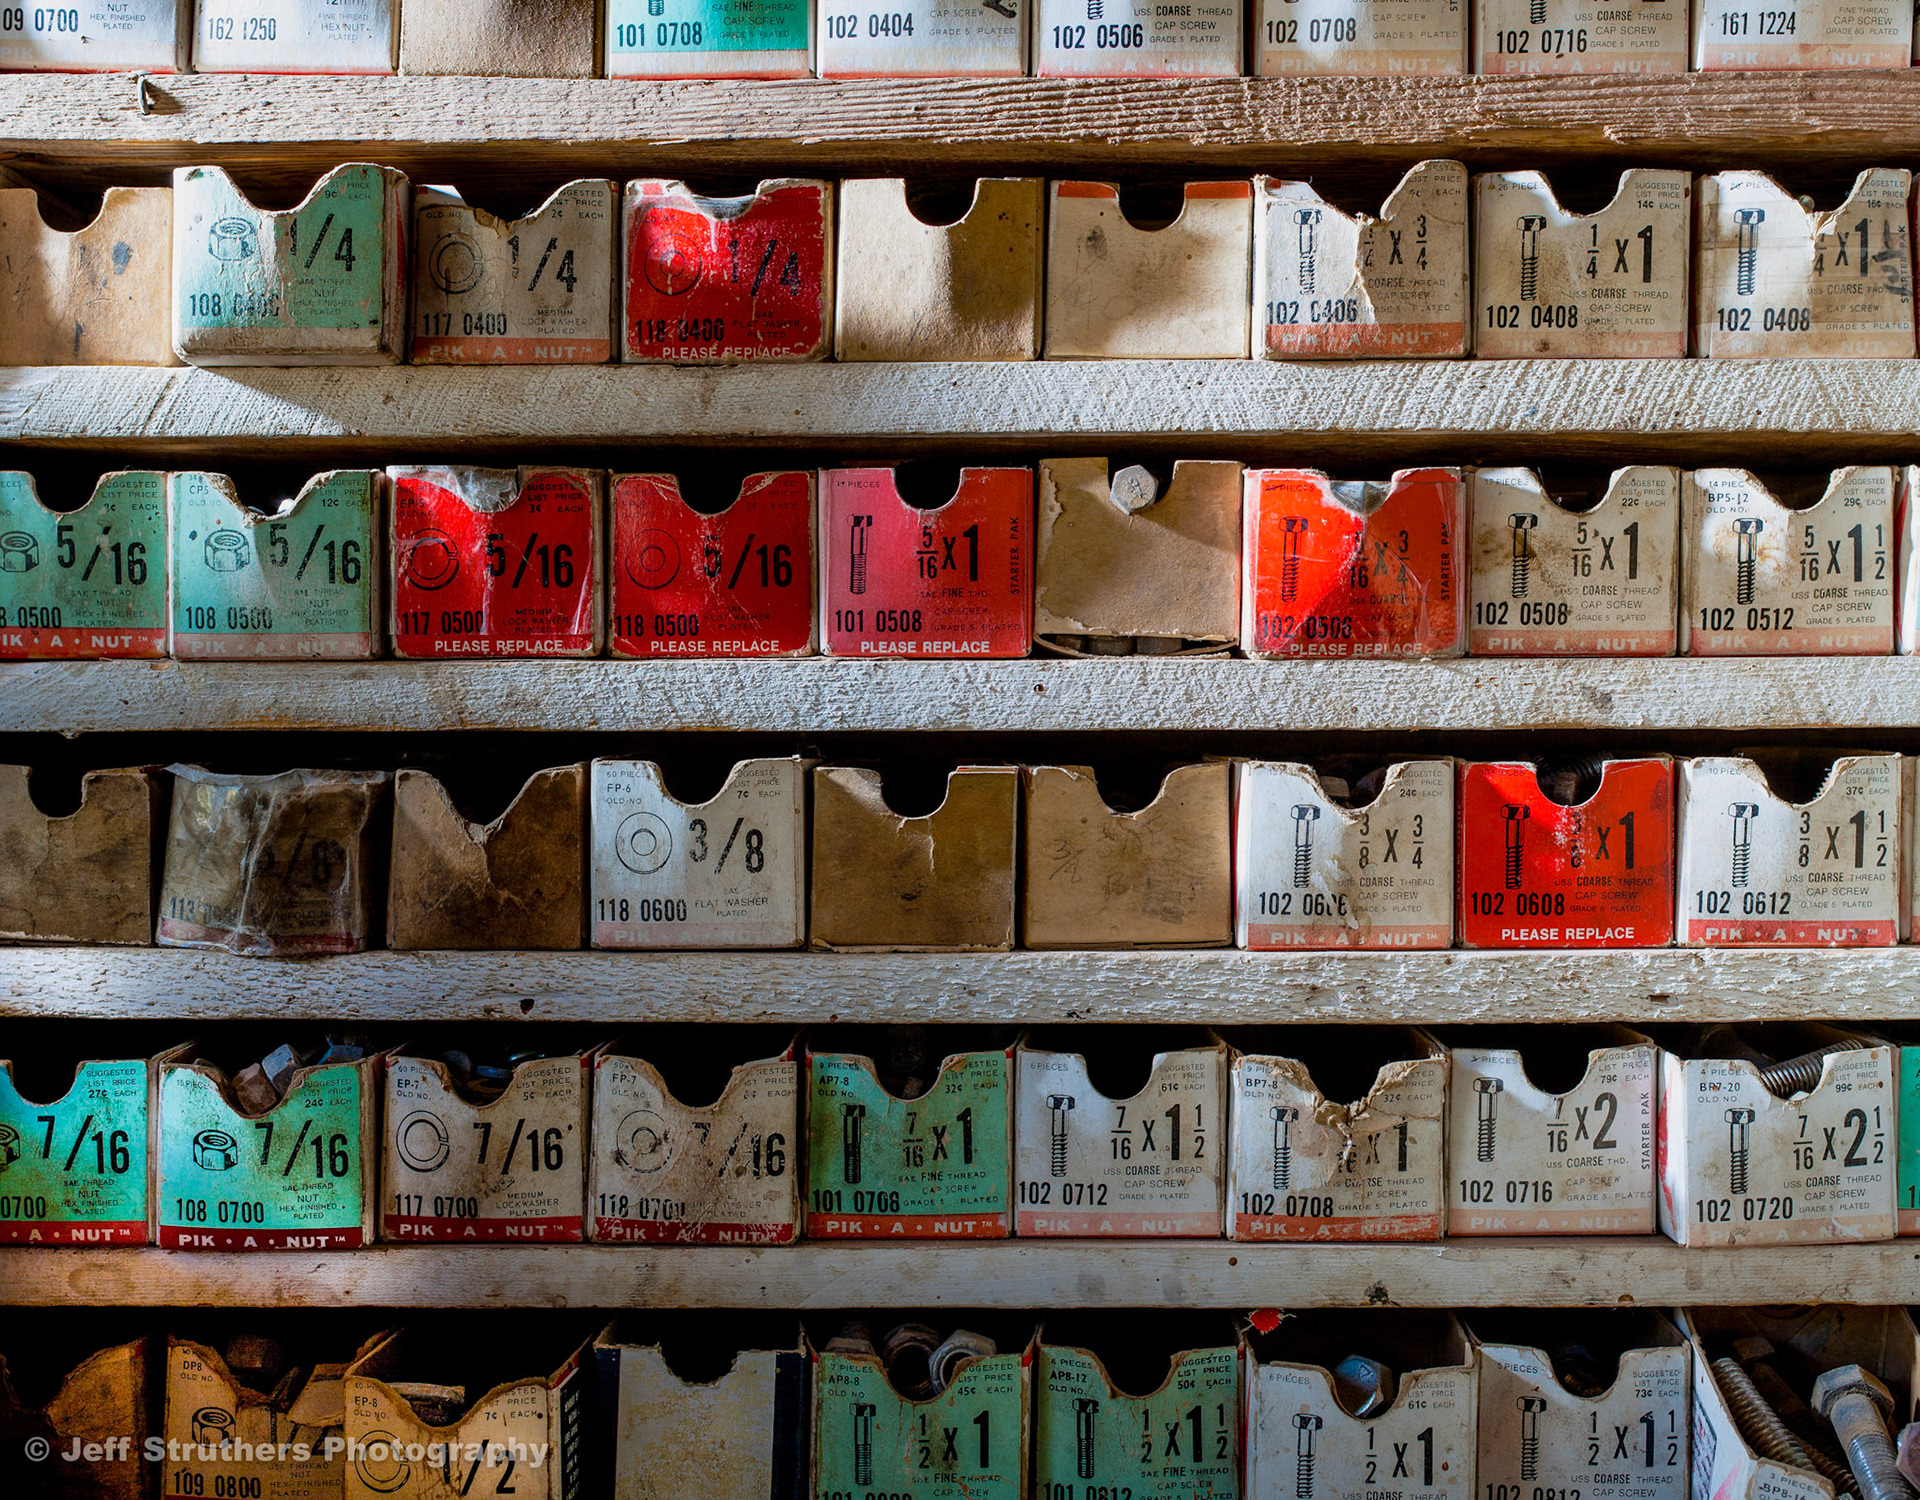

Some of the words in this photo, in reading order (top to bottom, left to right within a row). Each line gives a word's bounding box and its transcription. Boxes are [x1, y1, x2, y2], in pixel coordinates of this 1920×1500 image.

[1155, 5, 1192, 16] COARSE
[34, 8, 79, 32] 0700
[826, 15, 857, 39] 102
[869, 13, 915, 38] 0404
[1155, 20, 1177, 30] CAP
[1180, 20, 1218, 30] SCREW
[1721, 13, 1749, 36] 161
[1757, 12, 1796, 36] 1224
[1833, 16, 1854, 26] CAP
[1857, 16, 1893, 26] SCREW
[208, 18, 234, 40] 162
[243, 18, 277, 41] 1250
[617, 23, 646, 47] 101
[656, 21, 703, 47] 0708
[1052, 25, 1086, 49] 102
[1096, 24, 1145, 49] 0506
[1267, 20, 1299, 44] 102
[1309, 18, 1357, 43] 0708
[1496, 29, 1529, 54] 102
[1541, 28, 1588, 54] 0716
[1634, 182, 1681, 190] SUGGESTED
[1658, 202, 1681, 210] EACH
[578, 212, 605, 221] EACH
[1591, 287, 1628, 299] COARSE
[1632, 291, 1670, 299] THREAD
[189, 293, 222, 318] 108
[1266, 301, 1300, 325] 102
[1487, 305, 1520, 329] 102
[1530, 305, 1579, 329] 0408
[1717, 307, 1752, 332] 102
[1763, 307, 1812, 332] 0408
[422, 313, 453, 337] 117
[463, 312, 508, 336] 0400
[635, 318, 667, 343] 118
[677, 317, 725, 342] 0400
[662, 347, 720, 360] PLEASE
[847, 480, 881, 488] PIECES
[557, 505, 585, 513] EACH
[1645, 499, 1667, 507] EACH
[1009, 517, 1020, 541] PAK
[269, 523, 362, 585] 5/16
[486, 532, 574, 589] 5/16
[1009, 546, 1021, 596] STARTER
[941, 587, 965, 598] FINE
[1582, 586, 1619, 596] COARSE
[1475, 602, 1509, 626] 102
[1520, 602, 1569, 626] 0508
[1811, 602, 1834, 612] CAP
[1836, 602, 1873, 612] SCREW
[18, 607, 62, 629] 0500
[186, 606, 217, 630] 108
[227, 606, 274, 630] 0500
[402, 612, 430, 635] 117
[441, 611, 484, 634] 0500
[835, 609, 865, 633] 101
[875, 609, 923, 633] 0508
[1700, 607, 1736, 631] 102
[1746, 607, 1795, 632] 0512
[615, 614, 645, 637] 118
[653, 614, 700, 637] 0500
[434, 640, 491, 652] PLEASE
[496, 640, 564, 652] REPLACE
[650, 640, 707, 652] PLEASE
[712, 640, 780, 652] REPLACE
[860, 641, 918, 654] PLEASE
[922, 641, 991, 654] REPLACE
[1487, 637, 1525, 651] PIK
[607, 784, 632, 793] FP-6
[758, 790, 782, 798] EACH
[1868, 787, 1890, 795] EACH
[688, 816, 765, 875] 3/8
[1359, 877, 1395, 887] COARSE
[1808, 872, 1845, 883] COARSE
[1849, 874, 1887, 882] THREAD
[1806, 887, 1829, 896] CAP
[1831, 887, 1870, 896] SCREW
[598, 898, 630, 922] 118
[640, 898, 688, 922] 0600
[1259, 892, 1292, 916] 102
[1471, 892, 1504, 916] 102
[1516, 892, 1565, 917] 0608
[1695, 890, 1731, 914] 102
[1743, 891, 1793, 916] 0612
[1500, 928, 1560, 941] PLEASE
[1564, 927, 1635, 940] REPLACE
[1833, 1061, 1879, 1071] SUGGESTED
[397, 1078, 420, 1090] EP-7
[818, 1075, 850, 1086] AP7-8
[1245, 1078, 1278, 1090] BP7-8
[114, 1088, 138, 1097] EACH
[329, 1098, 353, 1106] EACH
[1640, 1092, 1650, 1116] PAK
[37, 1114, 130, 1175] 7/16
[255, 1119, 349, 1179] 7/16
[473, 1117, 564, 1176] 7/16
[1641, 1122, 1651, 1171] STARTER
[1566, 1156, 1605, 1169] COARSE
[1126, 1165, 1161, 1176] COARSE
[1805, 1175, 1842, 1187] COARSE
[1019, 1181, 1052, 1205] 102
[1062, 1183, 1109, 1206] 0712
[1459, 1180, 1494, 1204] 102
[1506, 1181, 1554, 1204] 0716
[1, 1196, 47, 1219] 0700
[394, 1194, 424, 1218] 117
[434, 1196, 480, 1219] 0700
[813, 1190, 843, 1213] 101
[853, 1191, 900, 1214] 0708
[1242, 1192, 1275, 1216] 102
[1285, 1195, 1334, 1218] 0708
[177, 1198, 208, 1223] 108
[218, 1201, 266, 1224] 0700
[1696, 1199, 1732, 1223] 102
[1743, 1197, 1793, 1221] 0720
[399, 1224, 435, 1237] PIK
[827, 1220, 863, 1234] PIK
[178, 1233, 217, 1247] PIK
[1504, 1362, 1539, 1374] PIECES
[828, 1375, 861, 1386] AP8-8
[1050, 1370, 1088, 1384] AP8-12
[1205, 1378, 1233, 1389] EACH
[987, 1385, 1014, 1394] EACH
[354, 1396, 379, 1407] EP-8
[1432, 1401, 1456, 1409] EACH
[510, 1410, 538, 1419] EACH
[173, 1471, 205, 1496] 109
[214, 1475, 262, 1499] 0800
[1594, 1473, 1631, 1484] COARSE
[1636, 1476, 1674, 1484] THREAD
